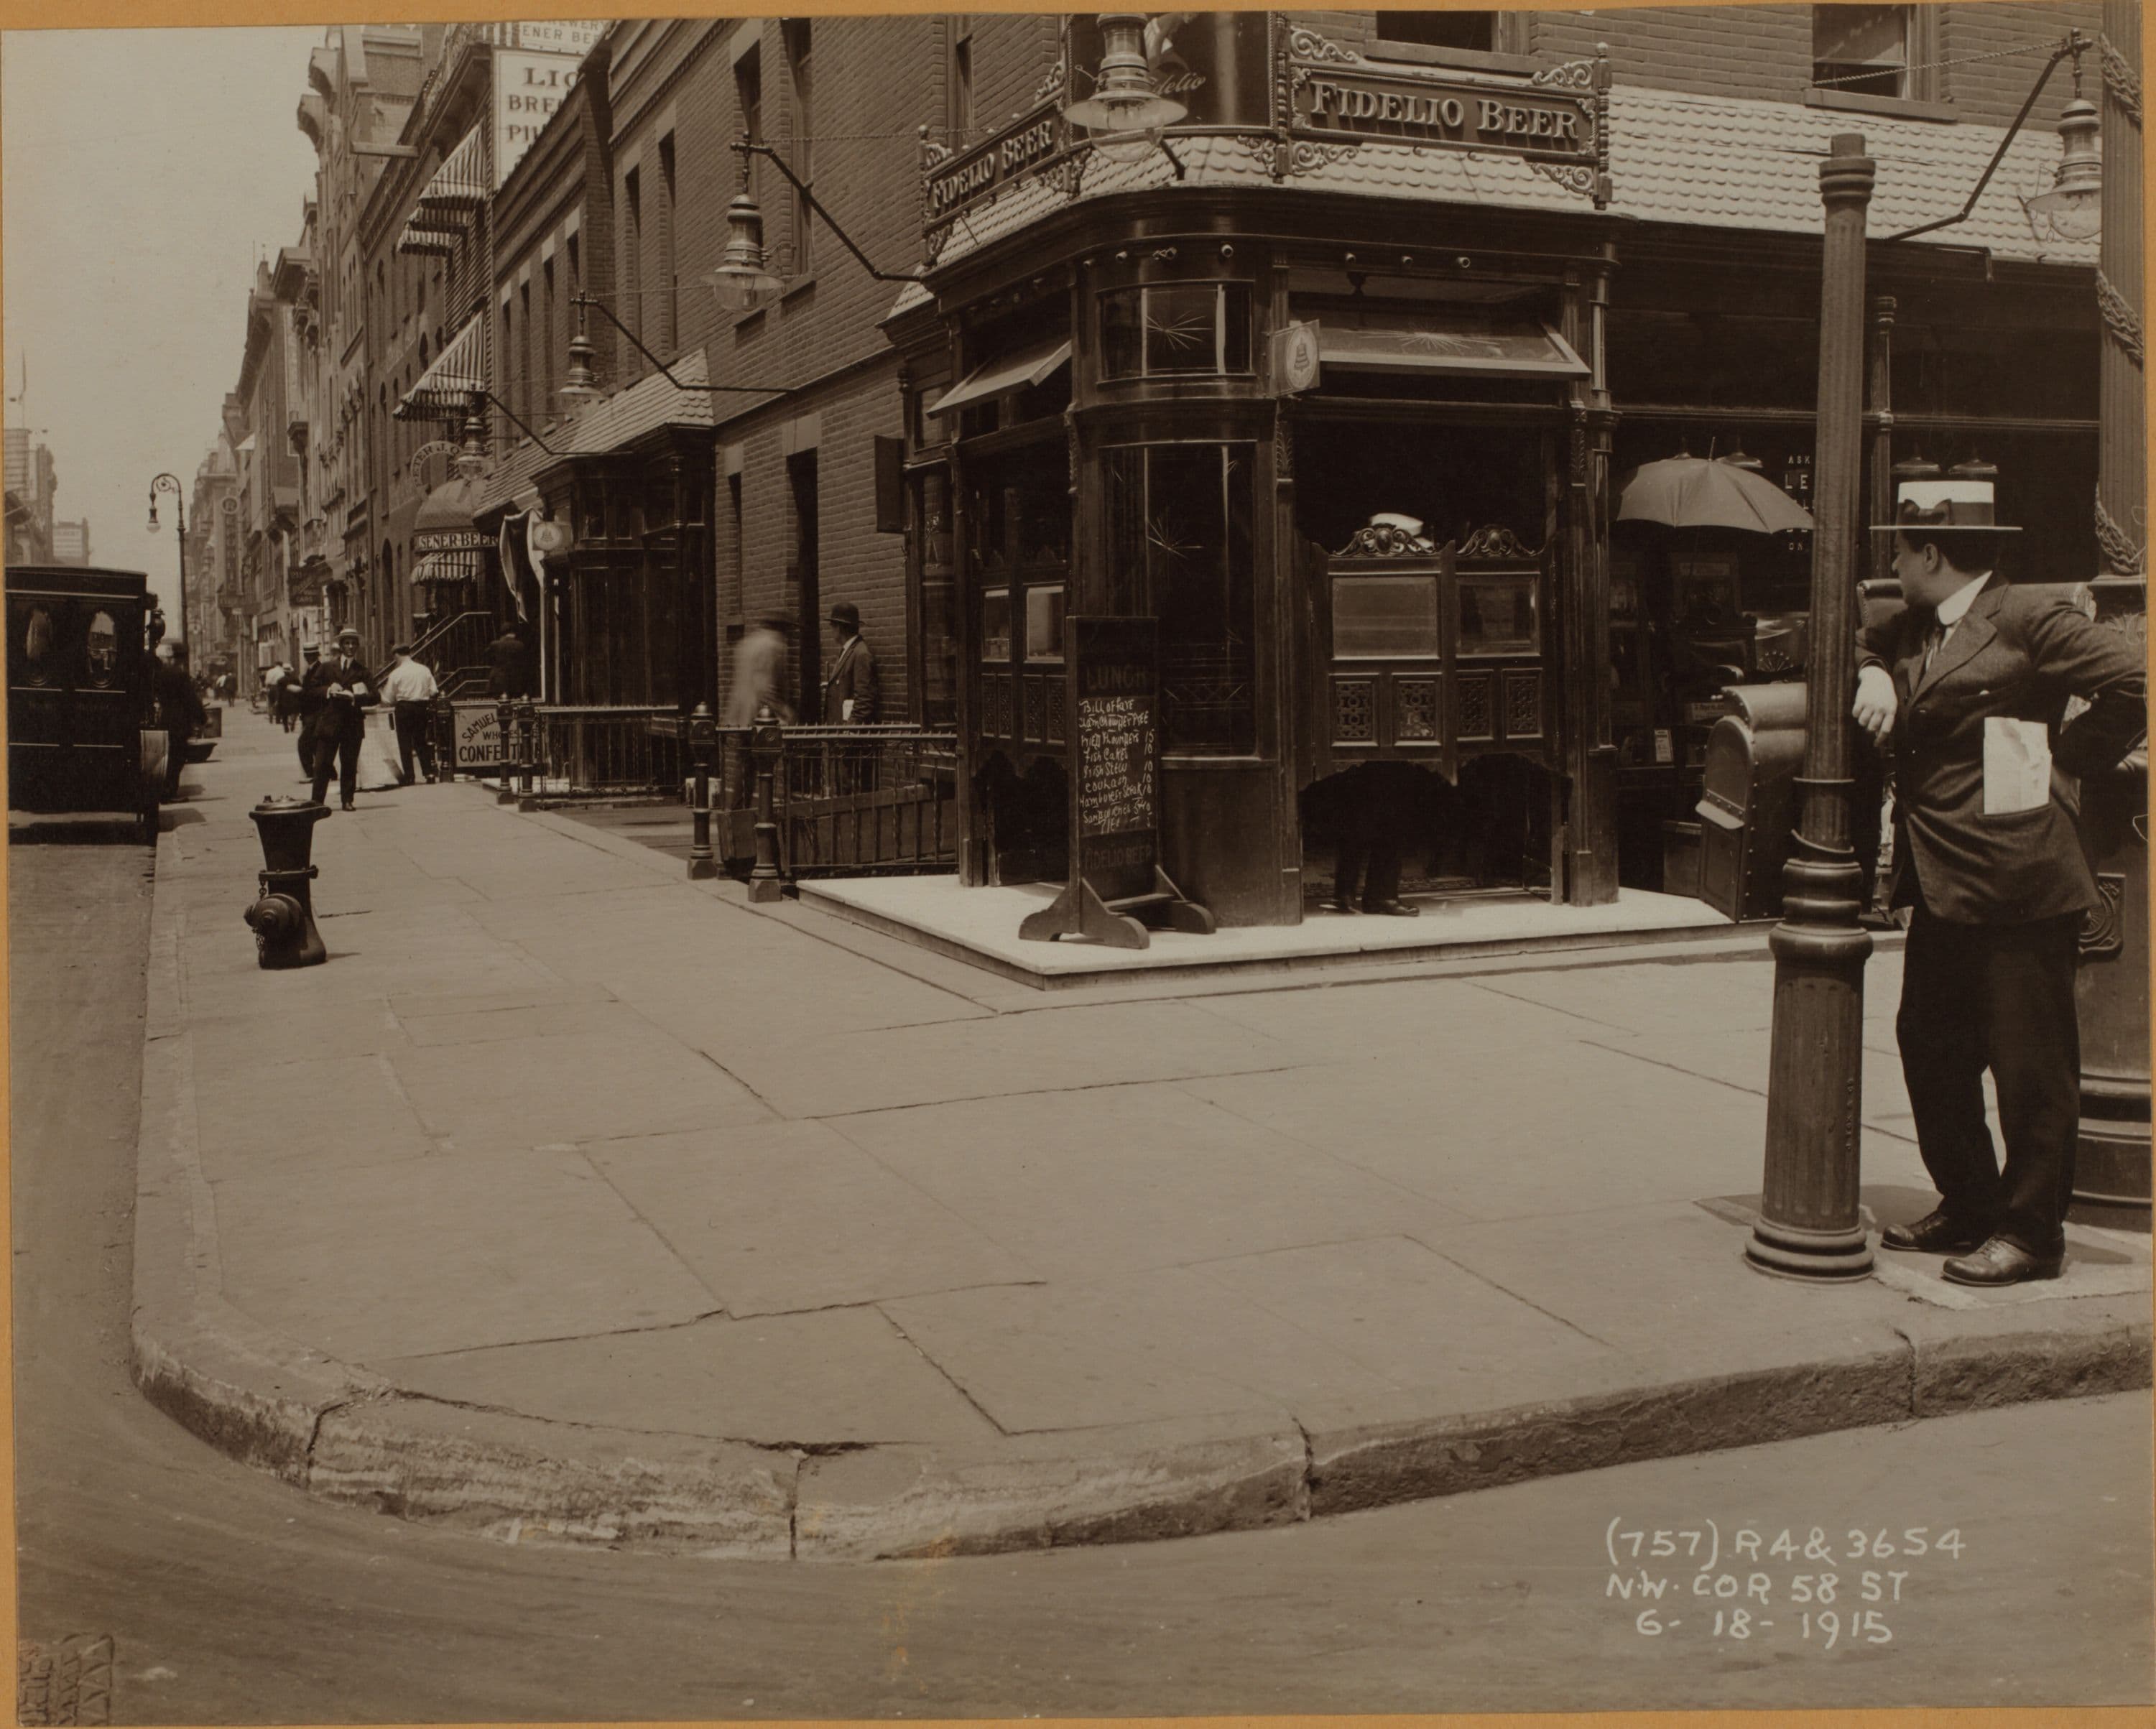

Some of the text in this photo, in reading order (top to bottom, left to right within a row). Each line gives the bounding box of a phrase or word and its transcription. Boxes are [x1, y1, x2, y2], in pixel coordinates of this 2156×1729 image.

[1310, 80, 1579, 139] FIDELIO BEER
[933, 121, 1052, 209] FIDELIO BEER
[462, 713, 497, 743] SAMUEL
